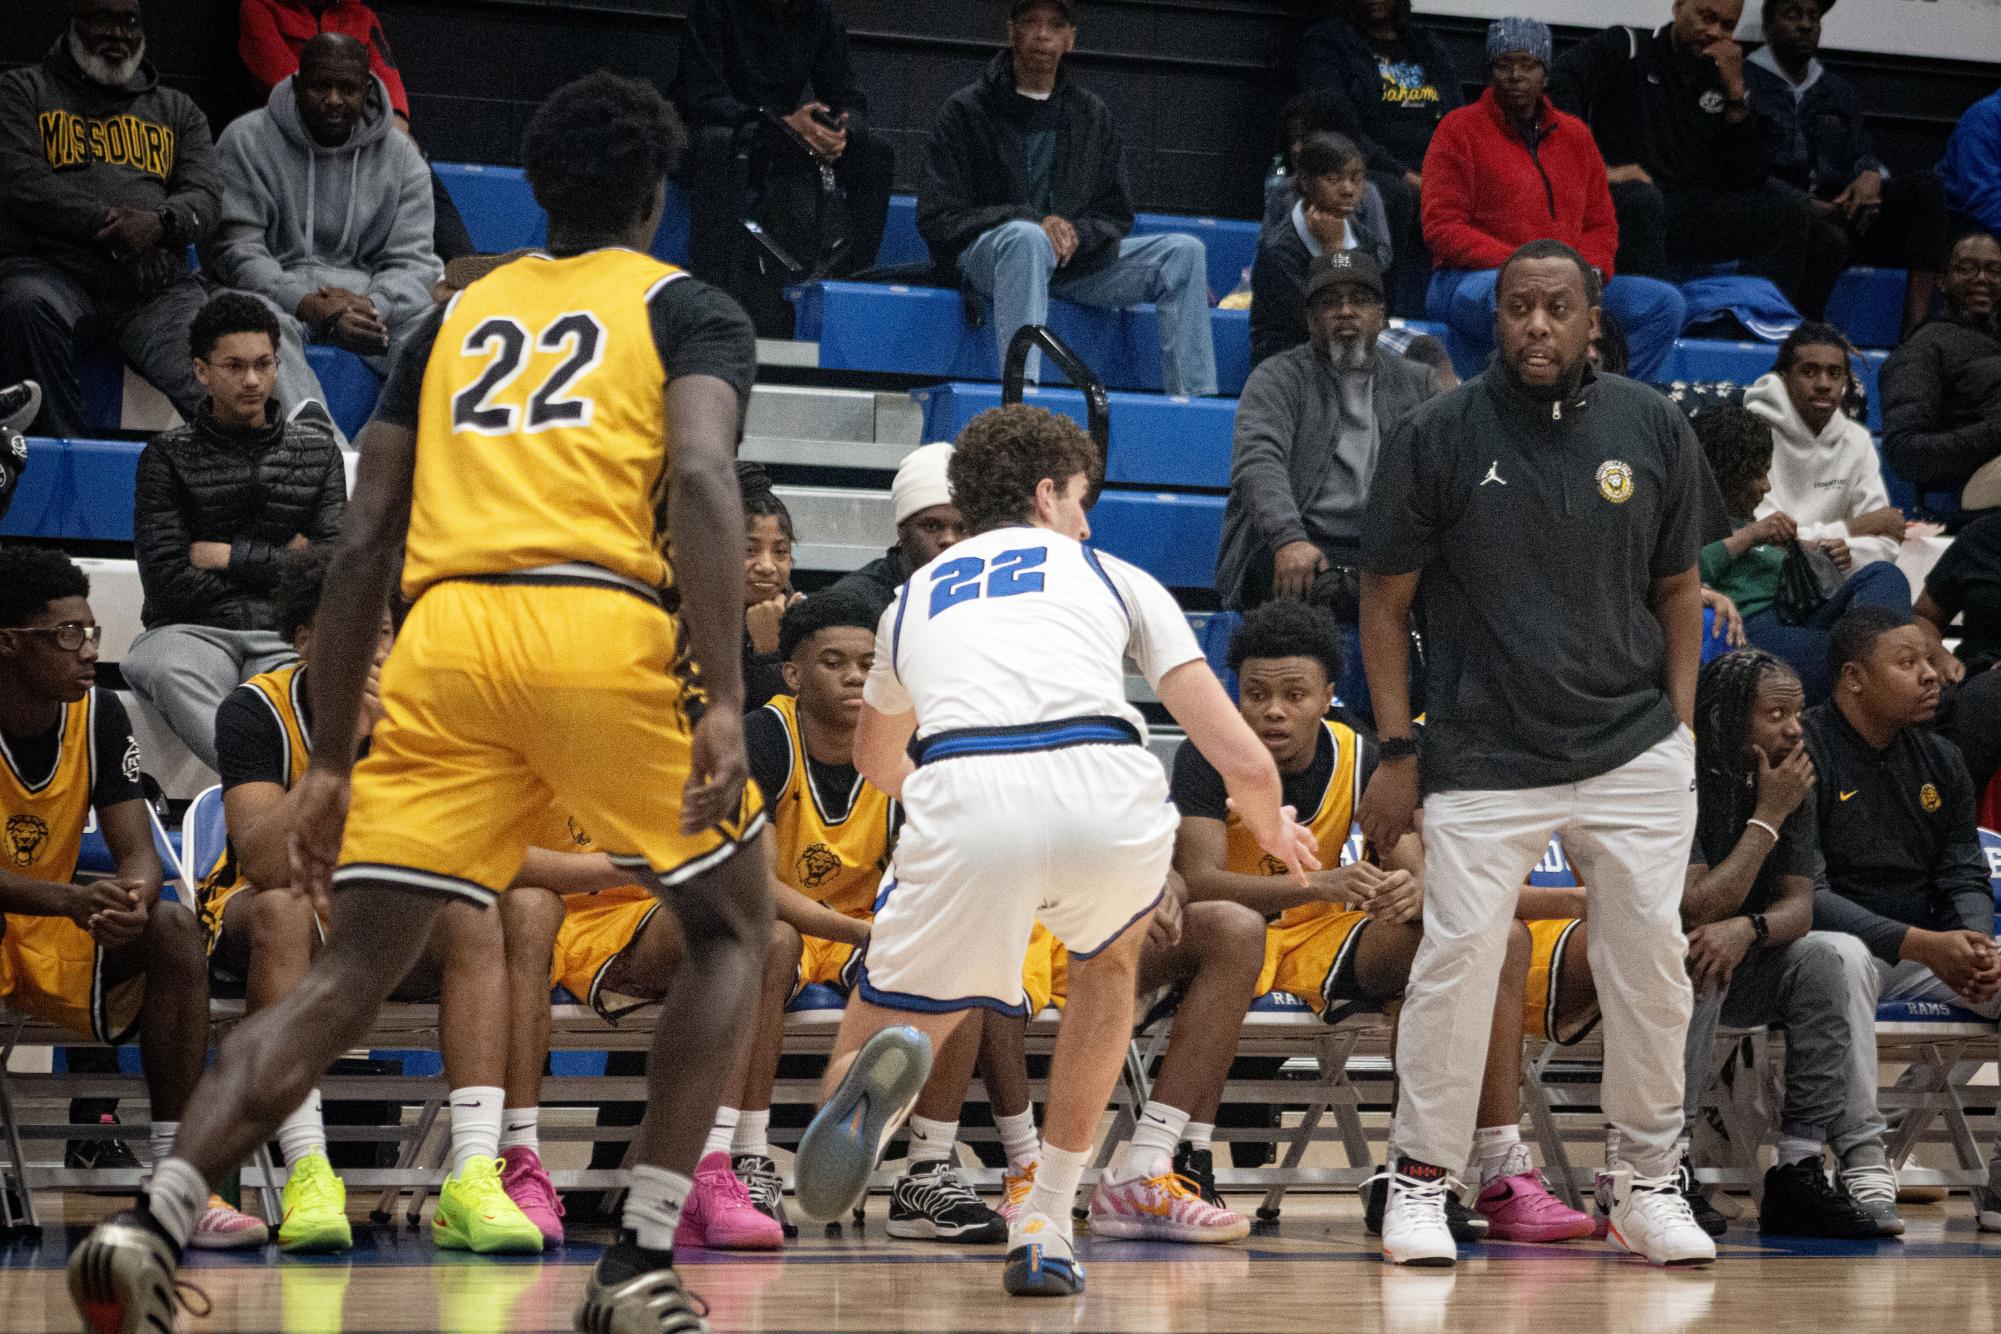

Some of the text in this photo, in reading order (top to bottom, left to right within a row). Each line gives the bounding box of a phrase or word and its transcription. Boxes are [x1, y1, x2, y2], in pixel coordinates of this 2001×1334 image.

[38, 108, 174, 182] MISSOURI
[452, 310, 607, 437] 22
[928, 546, 1047, 620] 22
[1271, 992, 1304, 1005] RA
[1906, 1002, 1951, 1016] RAMS
